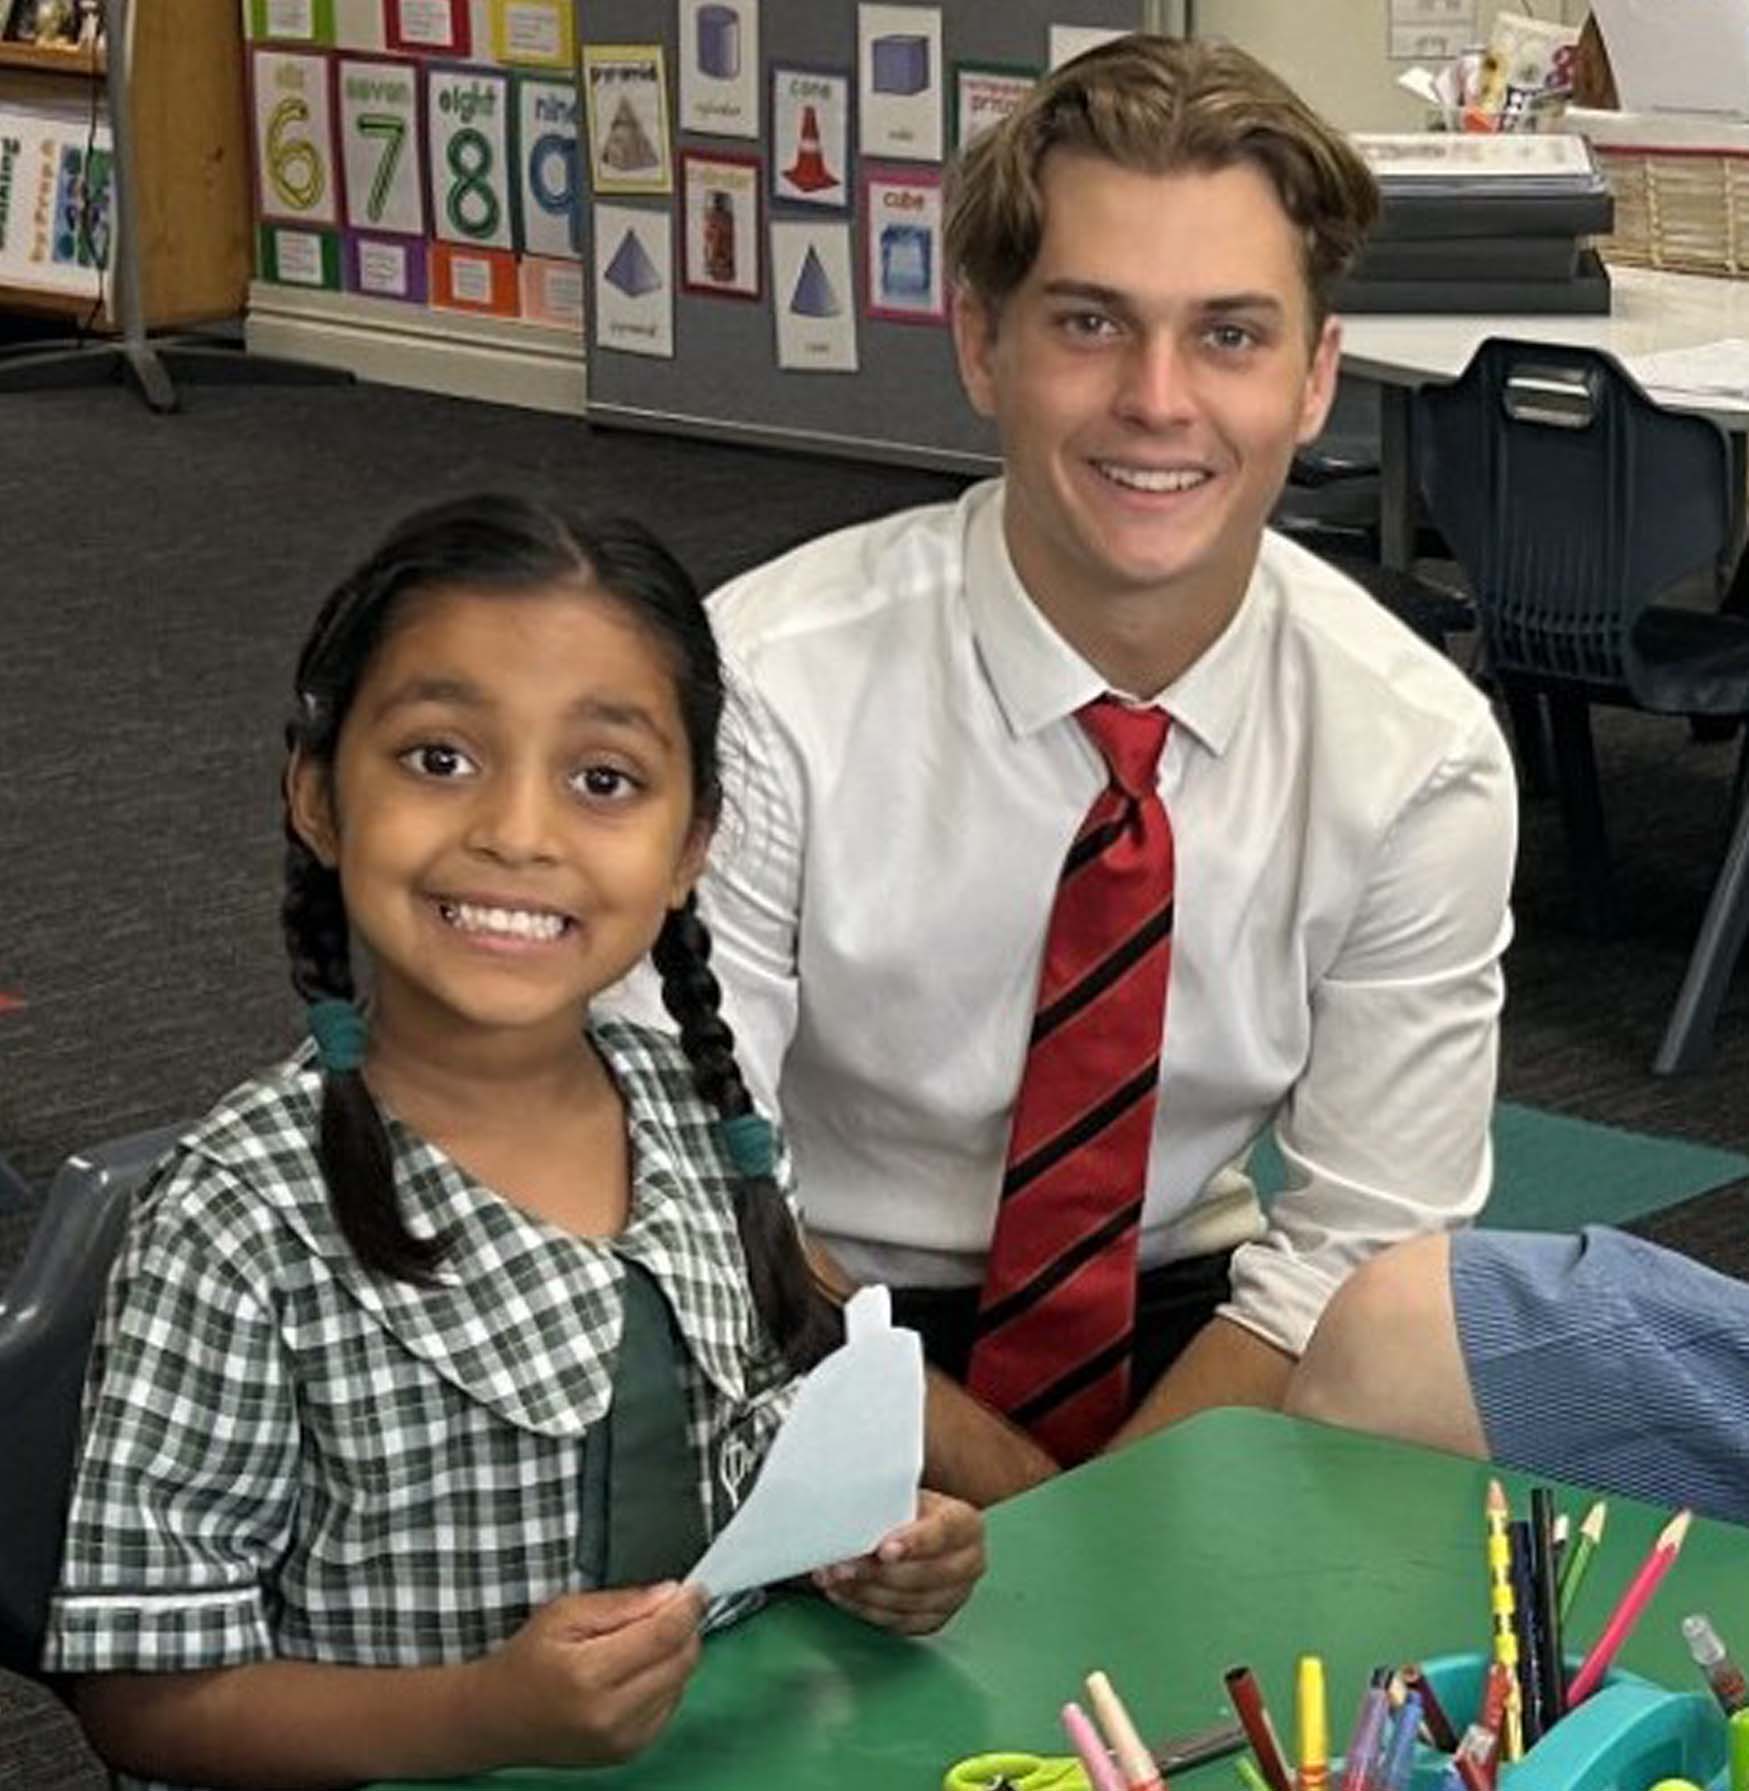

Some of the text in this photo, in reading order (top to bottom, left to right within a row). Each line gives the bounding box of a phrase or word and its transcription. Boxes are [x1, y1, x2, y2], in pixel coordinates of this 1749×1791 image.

[438, 82, 495, 123] eight
[789, 80, 831, 99] cone
[266, 97, 326, 212] 6
[356, 113, 406, 223] 7
[446, 127, 501, 240] 8
